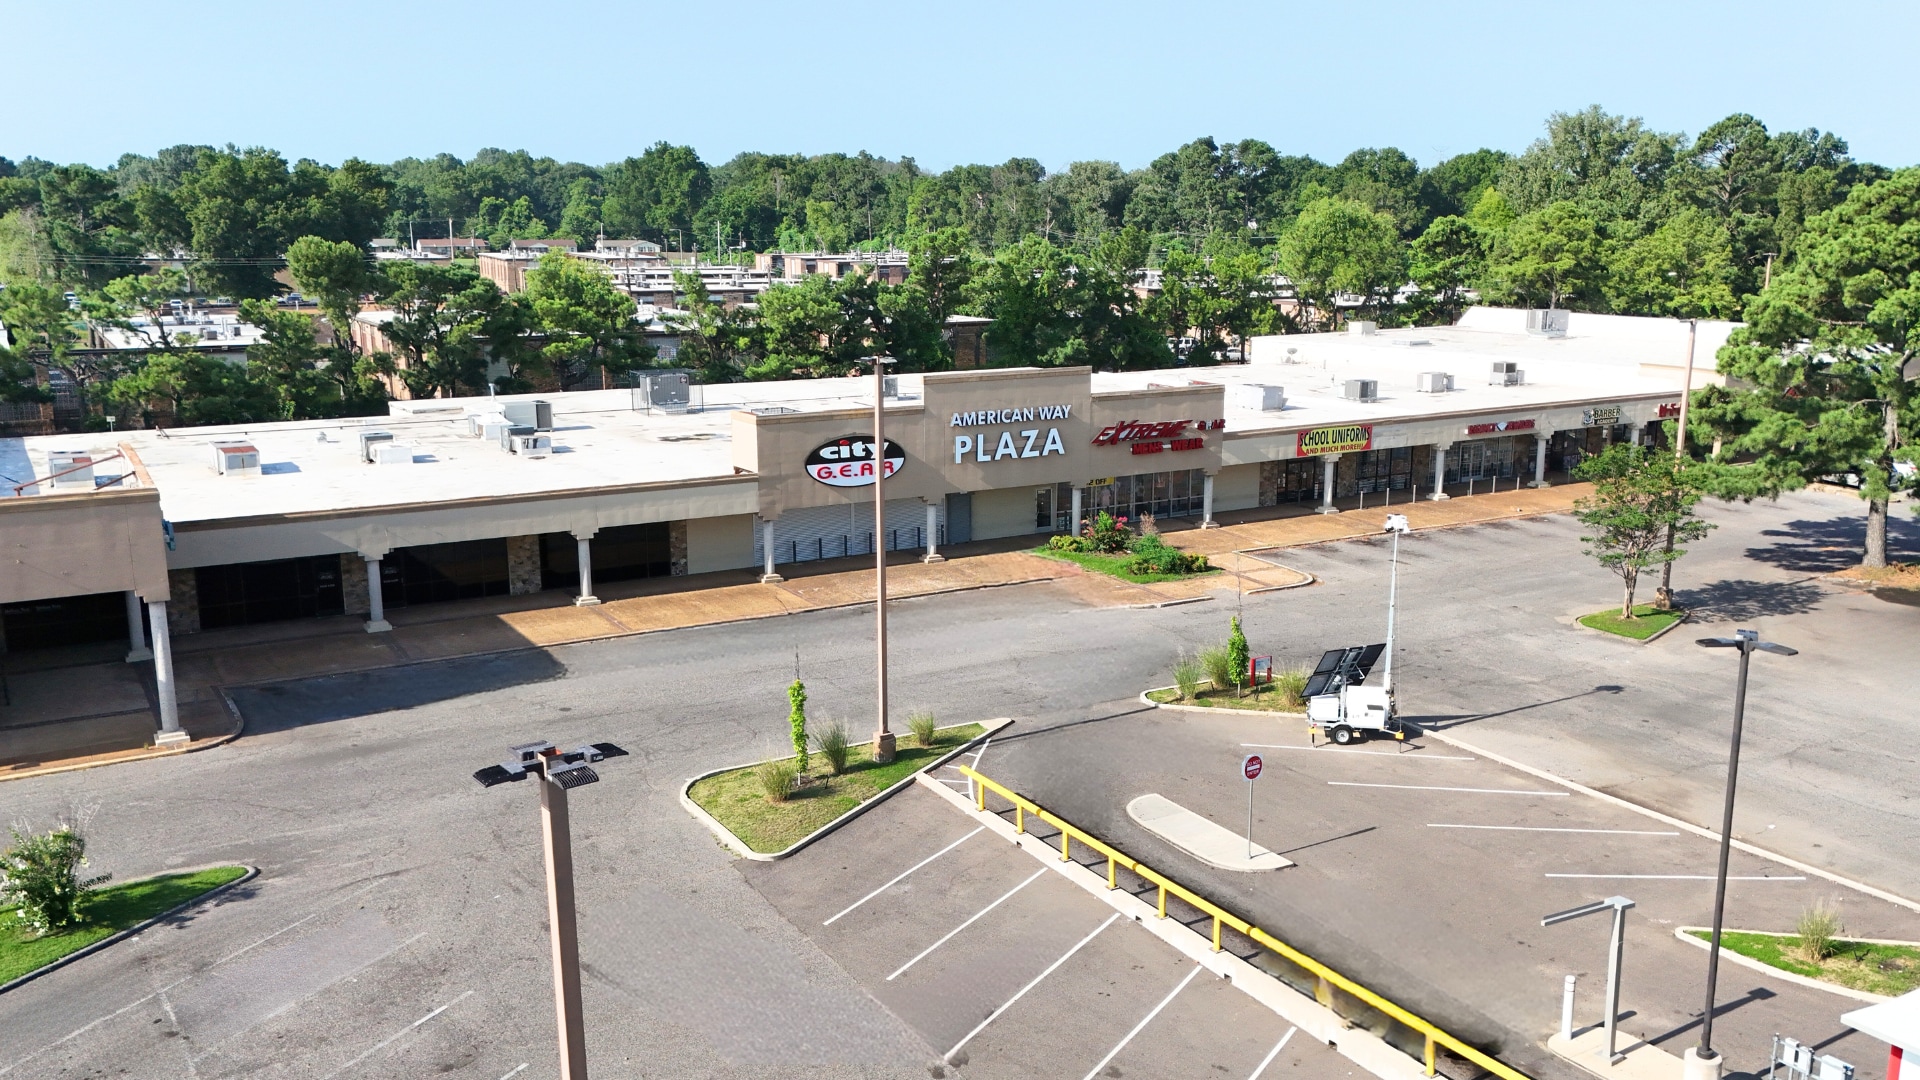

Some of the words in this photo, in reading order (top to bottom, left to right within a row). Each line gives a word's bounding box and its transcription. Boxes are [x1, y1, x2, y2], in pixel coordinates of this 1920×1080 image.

[949, 407, 1034, 427] AMERICAN
[1039, 404, 1071, 421] WAY
[1594, 408, 1621, 418] BARBER
[1091, 420, 1193, 446] EXTREME
[1300, 430, 1329, 447] SCHOOL
[1332, 427, 1370, 443] UNIFORMS
[954, 427, 1066, 464] PLAZA
[1170, 438, 1204, 451] WEAR
[1305, 447, 1318, 455] AND
[1320, 445, 1339, 453] MUCH
